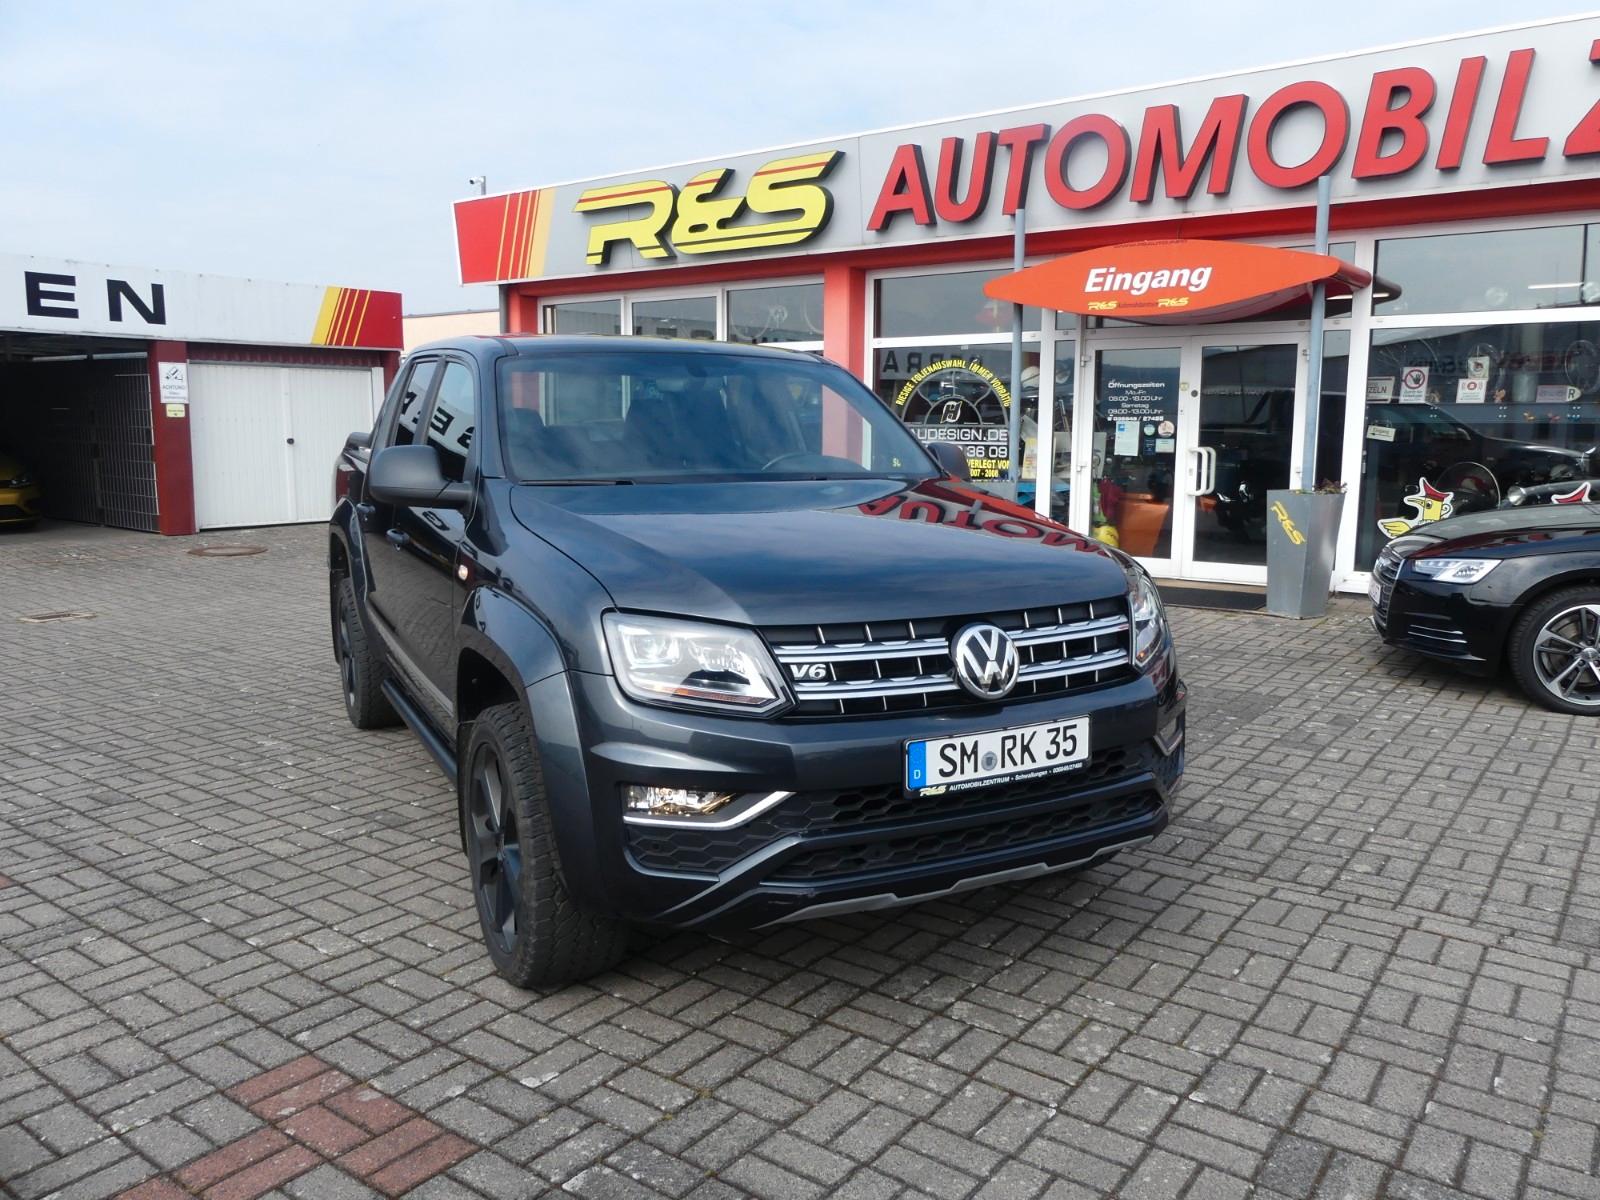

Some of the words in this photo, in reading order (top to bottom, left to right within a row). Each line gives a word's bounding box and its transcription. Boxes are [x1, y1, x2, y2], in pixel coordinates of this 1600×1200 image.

[574, 150, 845, 265] R&S
[1084, 265, 1213, 295] Eingang
[895, 382, 915, 406] RIESIGE
[911, 359, 967, 384] FOLIENAUSWAHL
[968, 362, 994, 380] IMMER
[911, 428, 1008, 441] UDESIGN.DE
[789, 663, 827, 680] V6
[938, 740, 979, 778] SM
[1000, 730, 1037, 769] RK
[1045, 724, 1078, 760] 35
[913, 769, 921, 780] D
[948, 776, 1010, 791] AUTOMOBILZENTRUM
